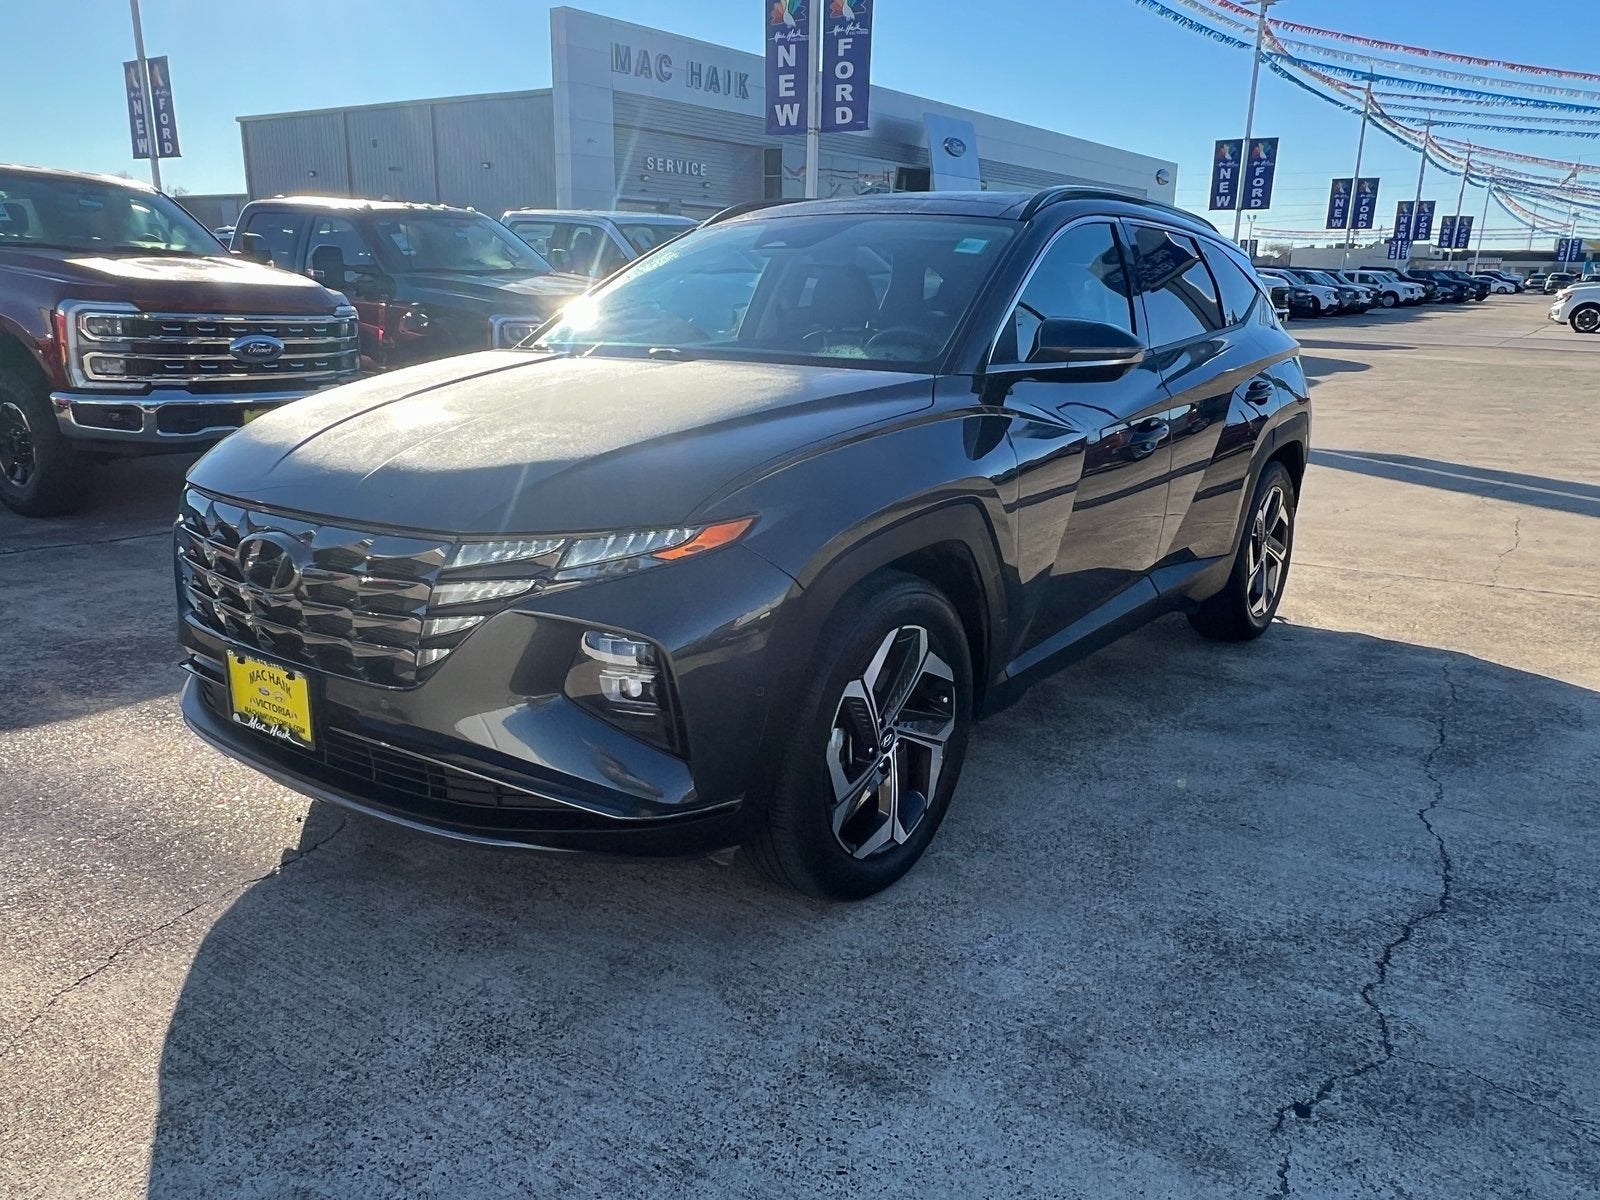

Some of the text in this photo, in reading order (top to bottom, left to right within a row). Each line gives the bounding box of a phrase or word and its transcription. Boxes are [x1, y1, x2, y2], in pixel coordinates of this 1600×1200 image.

[610, 42, 749, 99] MAC HAIK
[774, 44, 800, 127] NEW
[834, 37, 854, 125] FORD
[132, 99, 148, 154] NEW
[158, 98, 173, 154] FORD
[647, 157, 707, 176] SERVICE
[1215, 168, 1232, 207] NEW
[1250, 166, 1265, 207] FORD
[1331, 198, 1344, 228] NEW
[1357, 198, 1370, 228] FORD
[1397, 216, 1407, 239] NEW
[1440, 228, 1451, 247] NEW
[249, 670, 267, 684] MAC
[247, 715, 268, 732] Mac
[256, 698, 291, 719] VICTORIA
